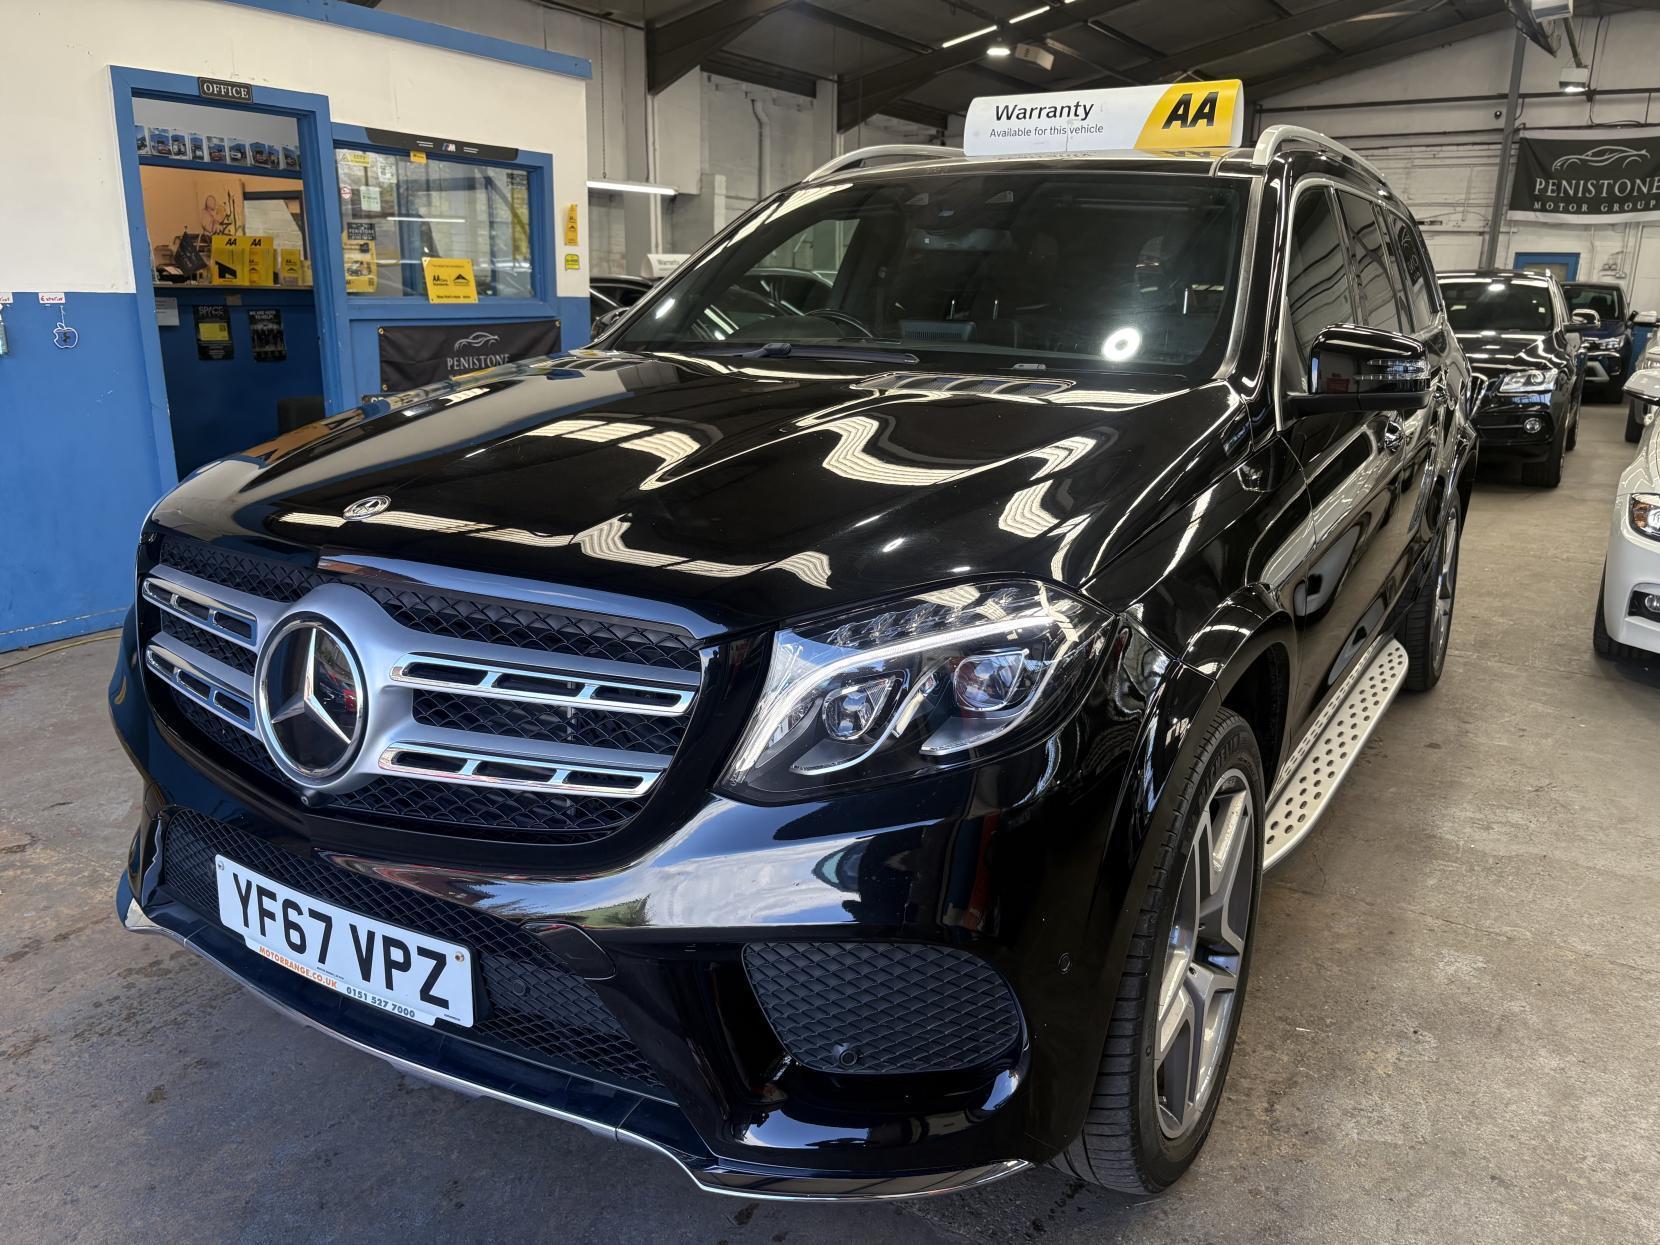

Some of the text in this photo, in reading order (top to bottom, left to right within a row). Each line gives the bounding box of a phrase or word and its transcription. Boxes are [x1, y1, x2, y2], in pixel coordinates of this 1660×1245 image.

[203, 82, 249, 99] OFFICE
[995, 91, 1220, 130] Warranty AA
[989, 124, 1104, 138] Available for this vehicle
[1533, 176, 1660, 197] PENISTONE
[1533, 200, 1657, 212] MOTOR GROUP
[225, 238, 237, 246] AA
[250, 238, 262, 247] AA
[446, 353, 511, 370] PENISTONE
[232, 872, 450, 1010] YF67 VPZ
[258, 945, 337, 989] MOTORRANGE.CO.UK
[346, 986, 368, 1002] 0151
[371, 995, 389, 1009] 527
[391, 1003, 416, 1019] 7000
